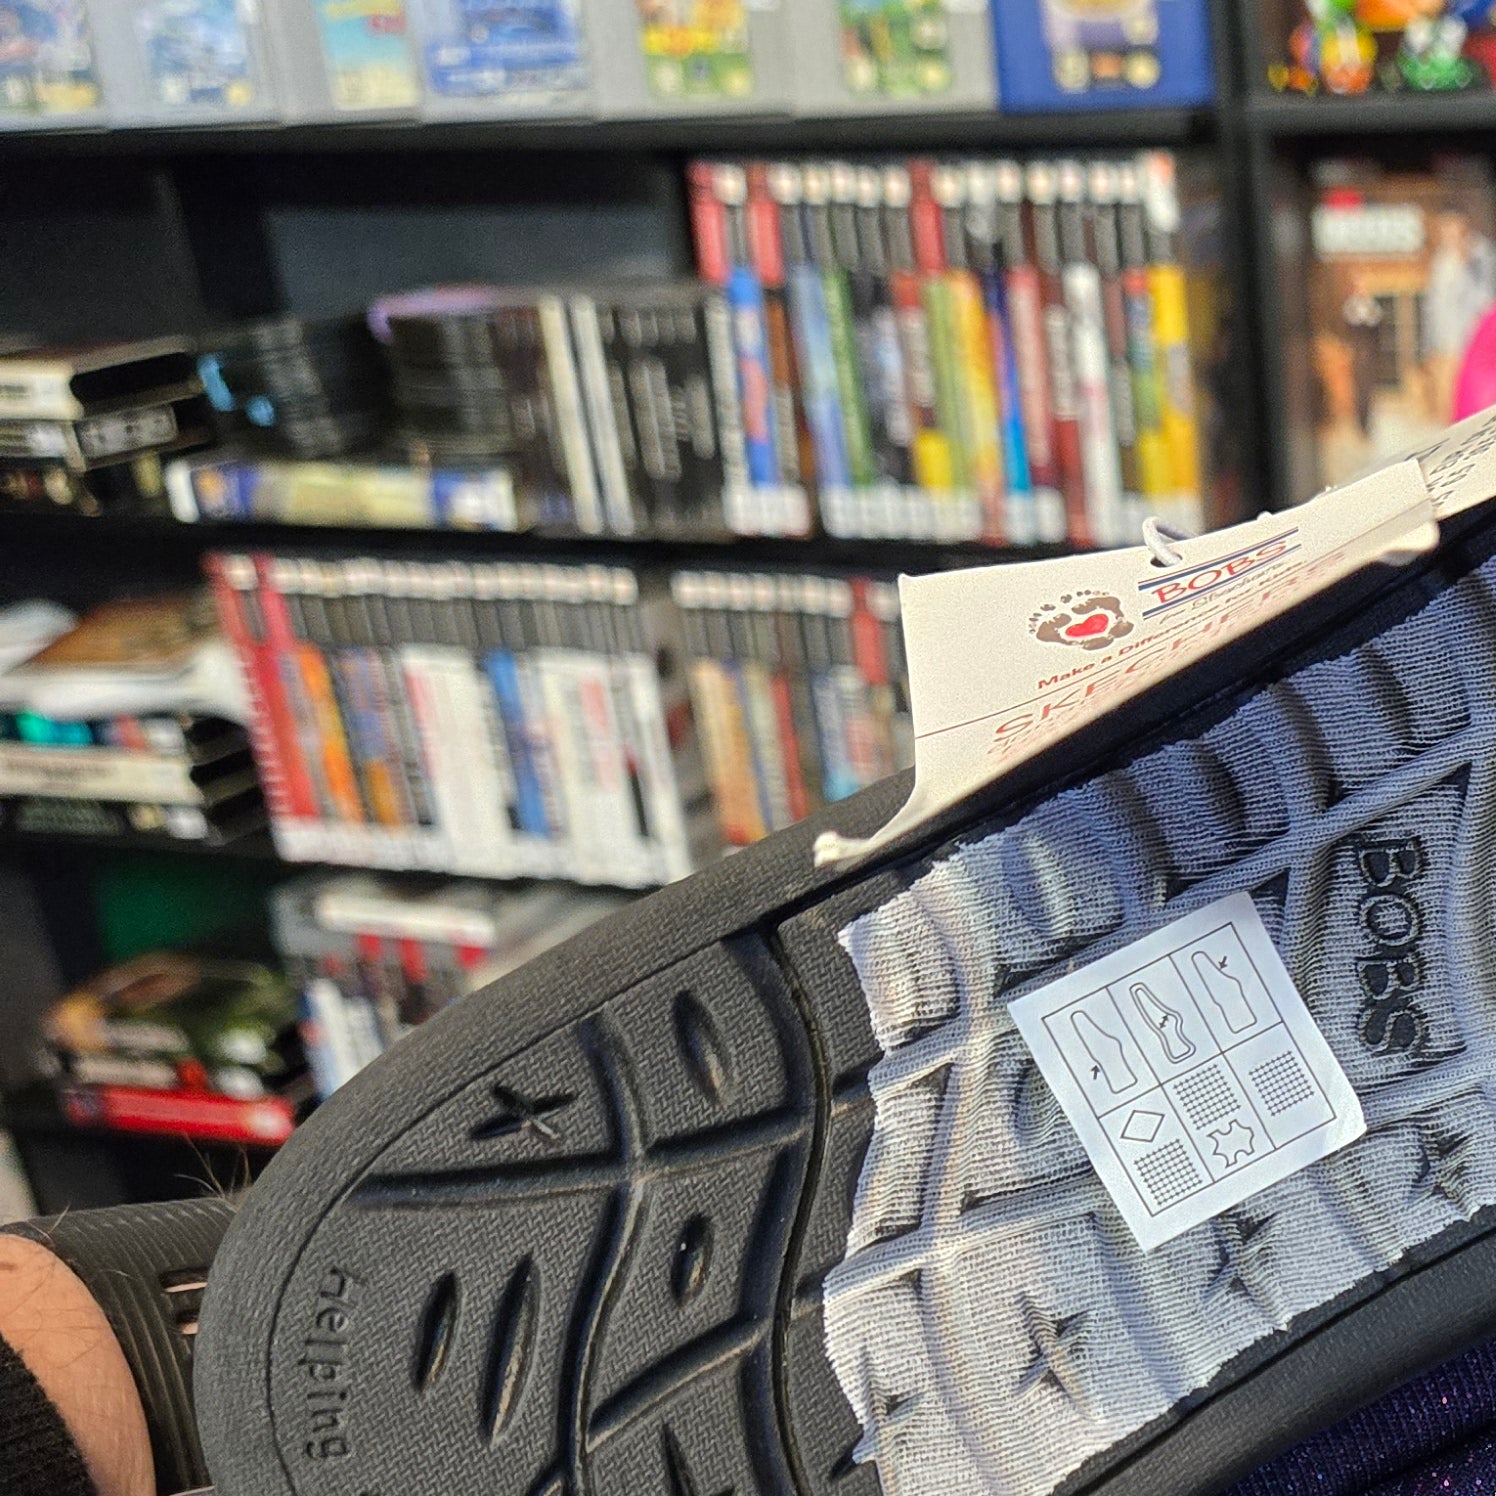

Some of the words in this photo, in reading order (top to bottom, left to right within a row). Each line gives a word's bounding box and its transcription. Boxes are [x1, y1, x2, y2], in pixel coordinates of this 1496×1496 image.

[1151, 541, 1287, 604] BOBS
[992, 551, 1346, 743] SKECHERS
[1037, 663, 1095, 690] Make
[1100, 655, 1112, 664] a
[1355, 834, 1428, 1058] BOBS
